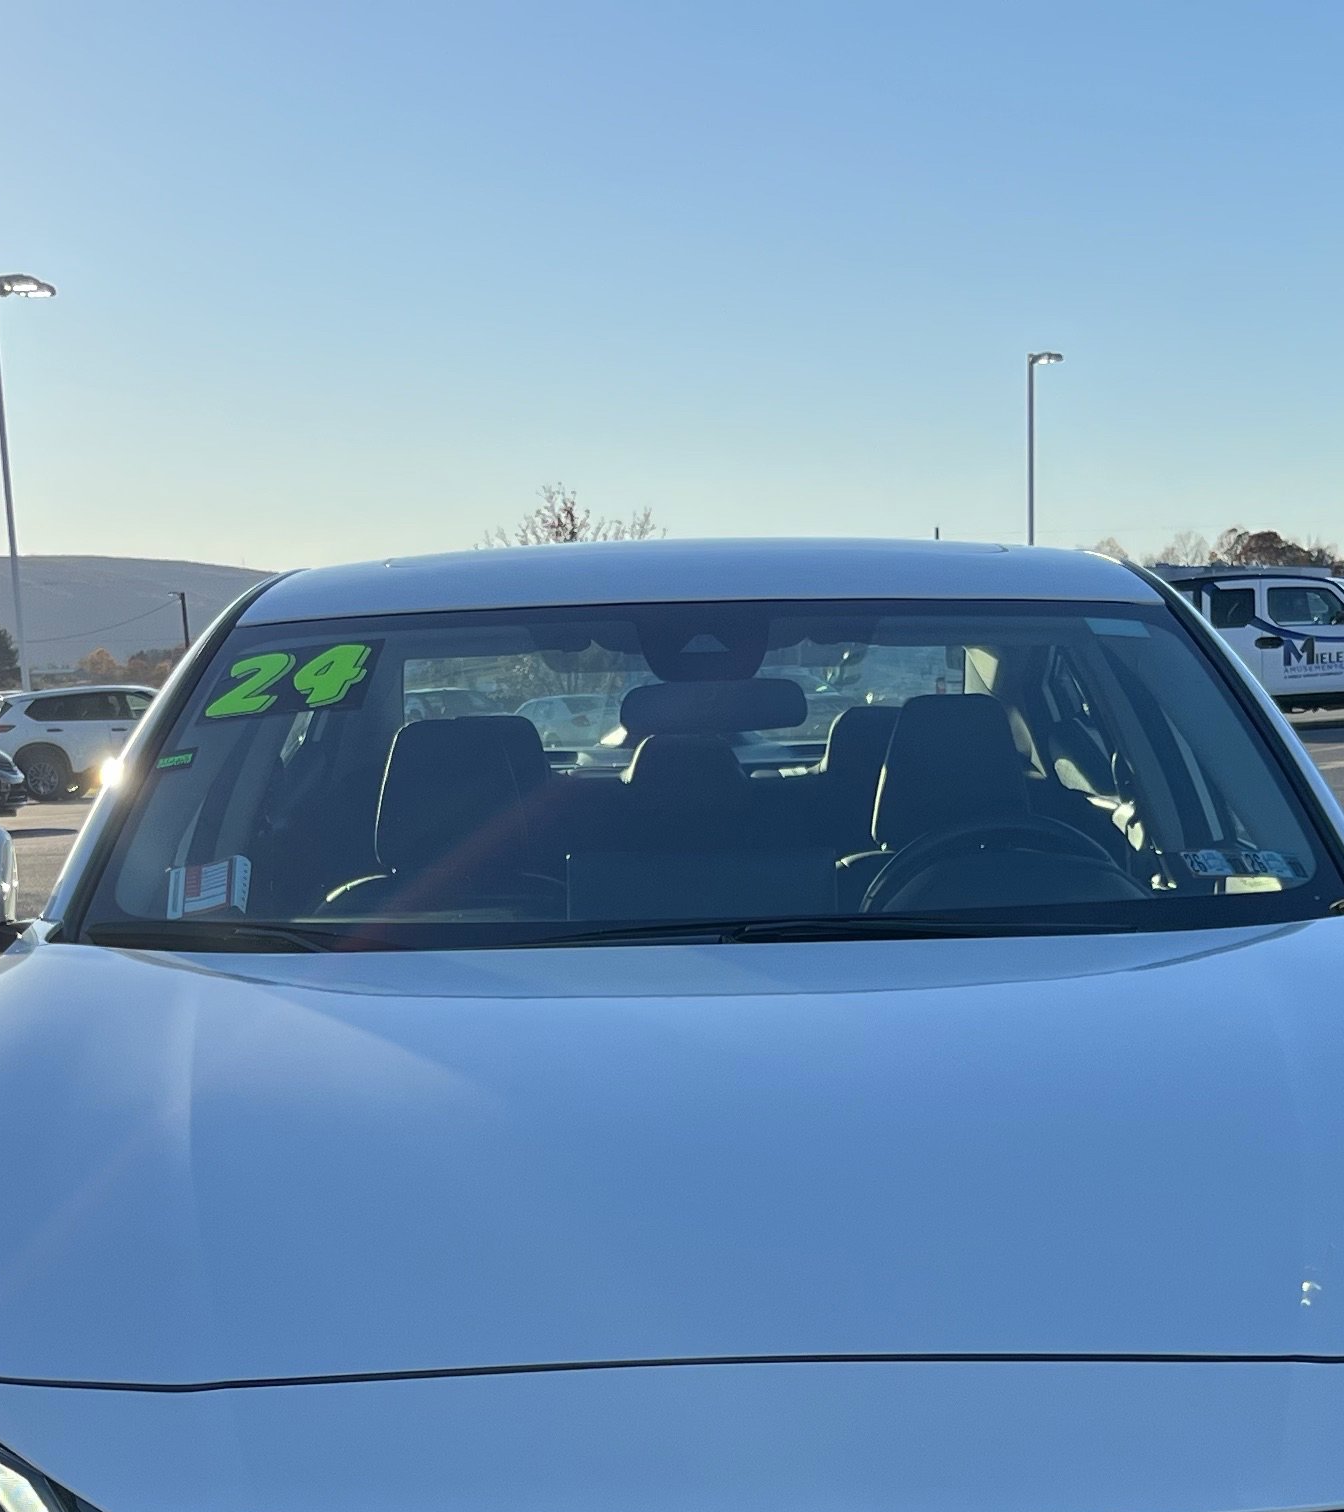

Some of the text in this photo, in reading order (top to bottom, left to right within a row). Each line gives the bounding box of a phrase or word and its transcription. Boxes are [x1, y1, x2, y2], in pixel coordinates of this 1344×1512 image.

[1283, 637, 1344, 666] MIELE
[205, 642, 372, 719] 24
[1182, 853, 1208, 873] 26
[1244, 853, 1268, 874] 26
